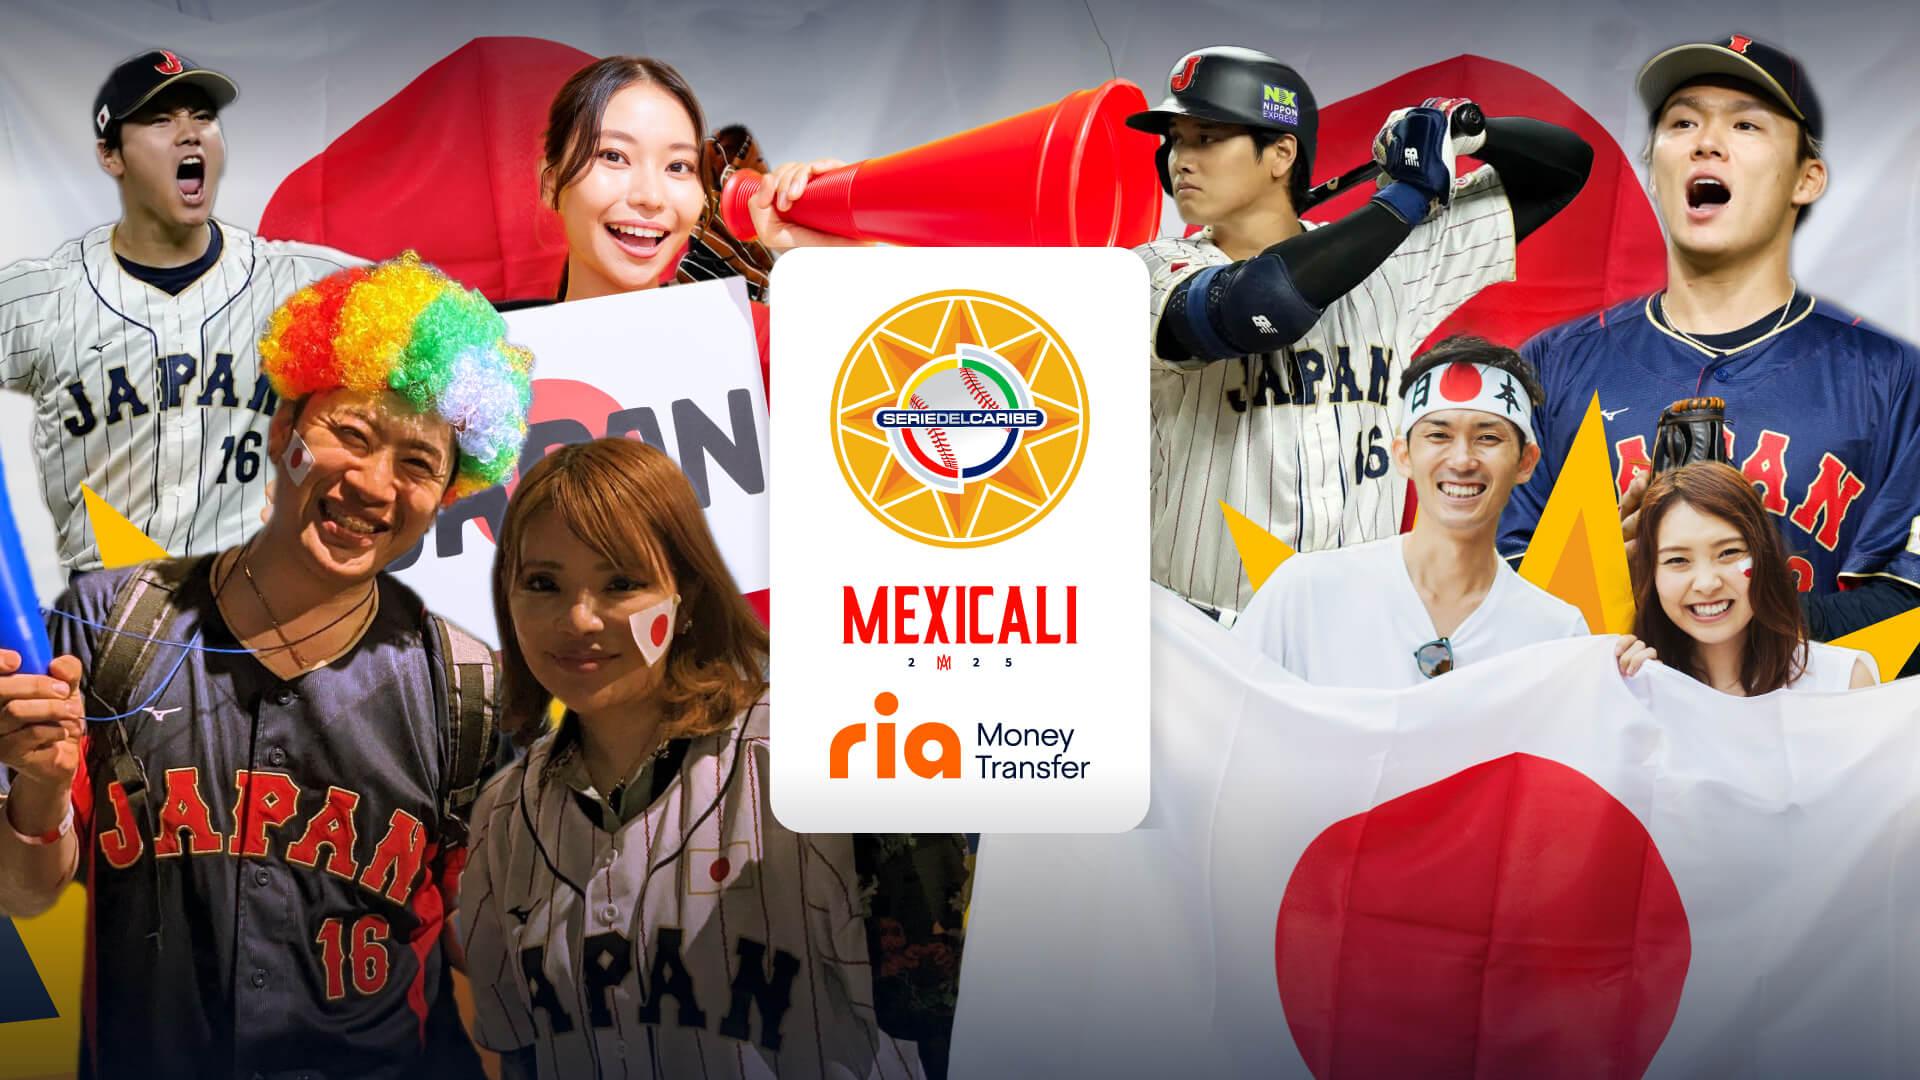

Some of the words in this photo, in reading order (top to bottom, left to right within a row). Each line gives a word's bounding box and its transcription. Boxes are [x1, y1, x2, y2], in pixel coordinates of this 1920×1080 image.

[1170, 55, 1202, 92] J
[1263, 101, 1298, 117] NIPPON
[1263, 110, 1297, 125] EXPRESS
[1226, 344, 1393, 414] JAPAN
[216, 430, 262, 484] 16
[1355, 424, 1390, 486] 16
[99, 766, 427, 905] JAPAN
[316, 914, 391, 1000] 16
